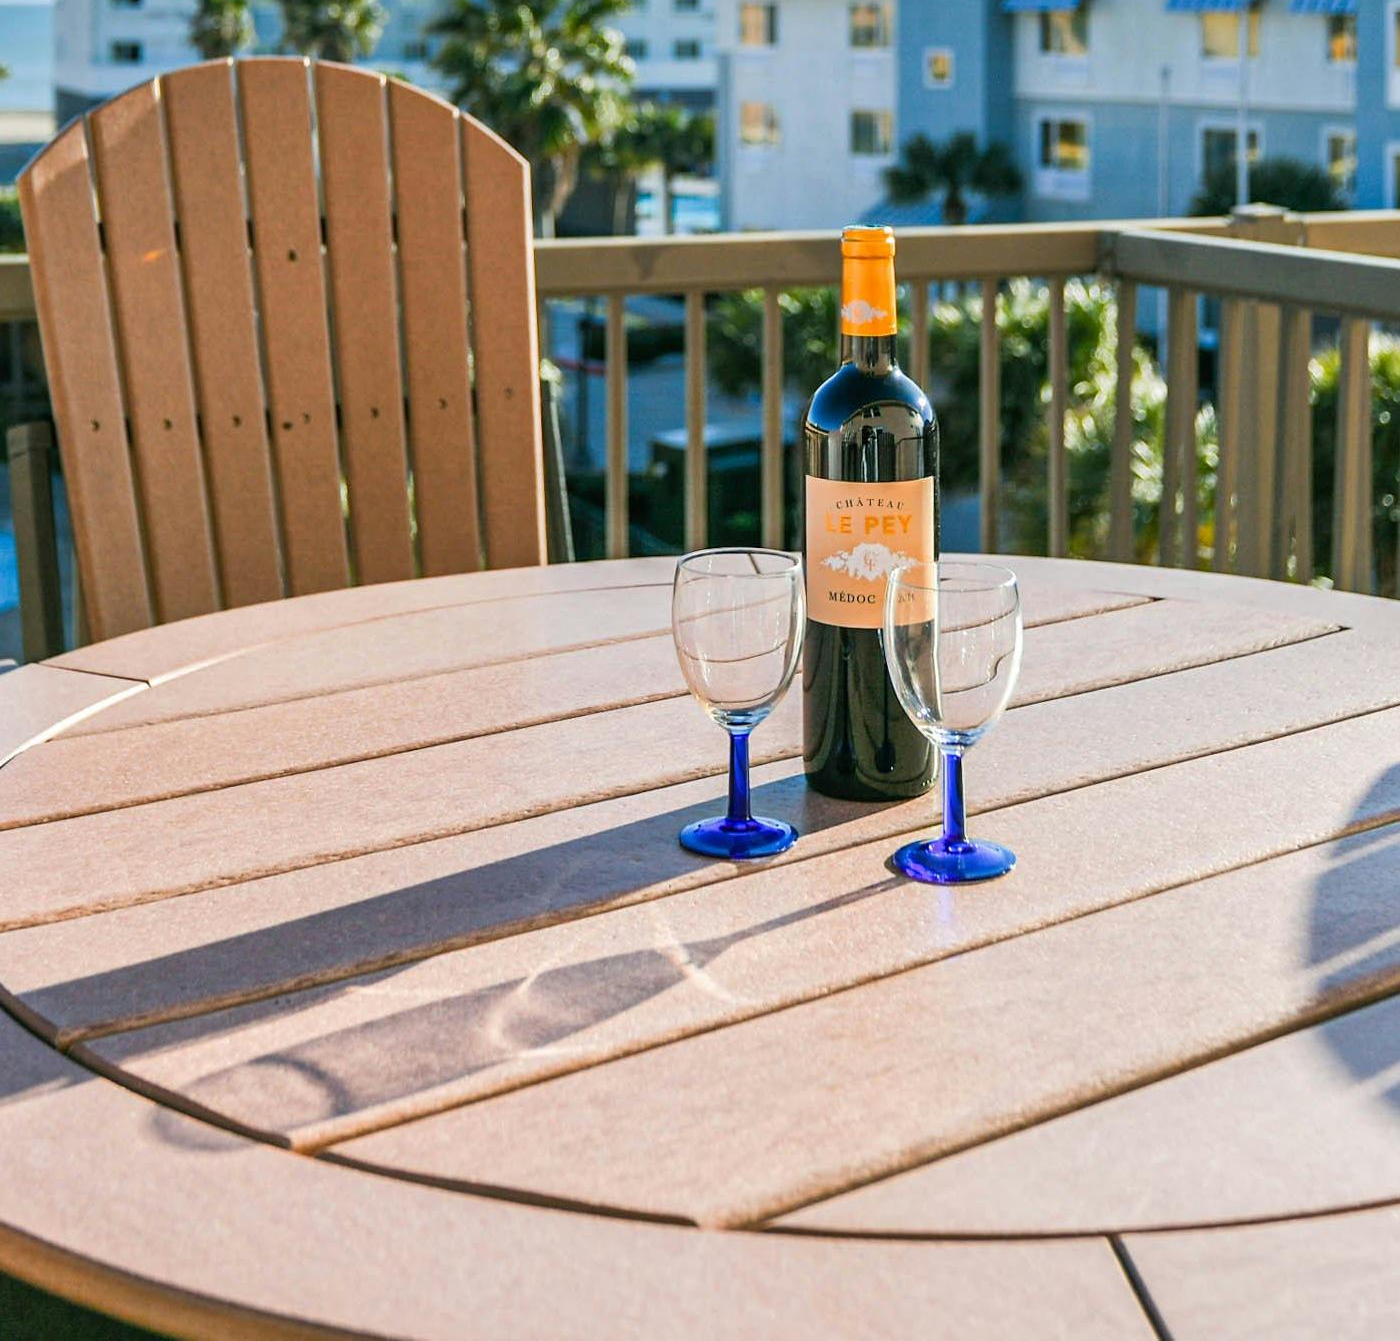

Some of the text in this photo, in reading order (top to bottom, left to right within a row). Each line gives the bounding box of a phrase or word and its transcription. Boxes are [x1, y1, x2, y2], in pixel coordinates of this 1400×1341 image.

[836, 497, 904, 510] CHÂTEAU
[825, 514, 912, 535] LE PEY
[829, 590, 876, 604] MÉDOC
